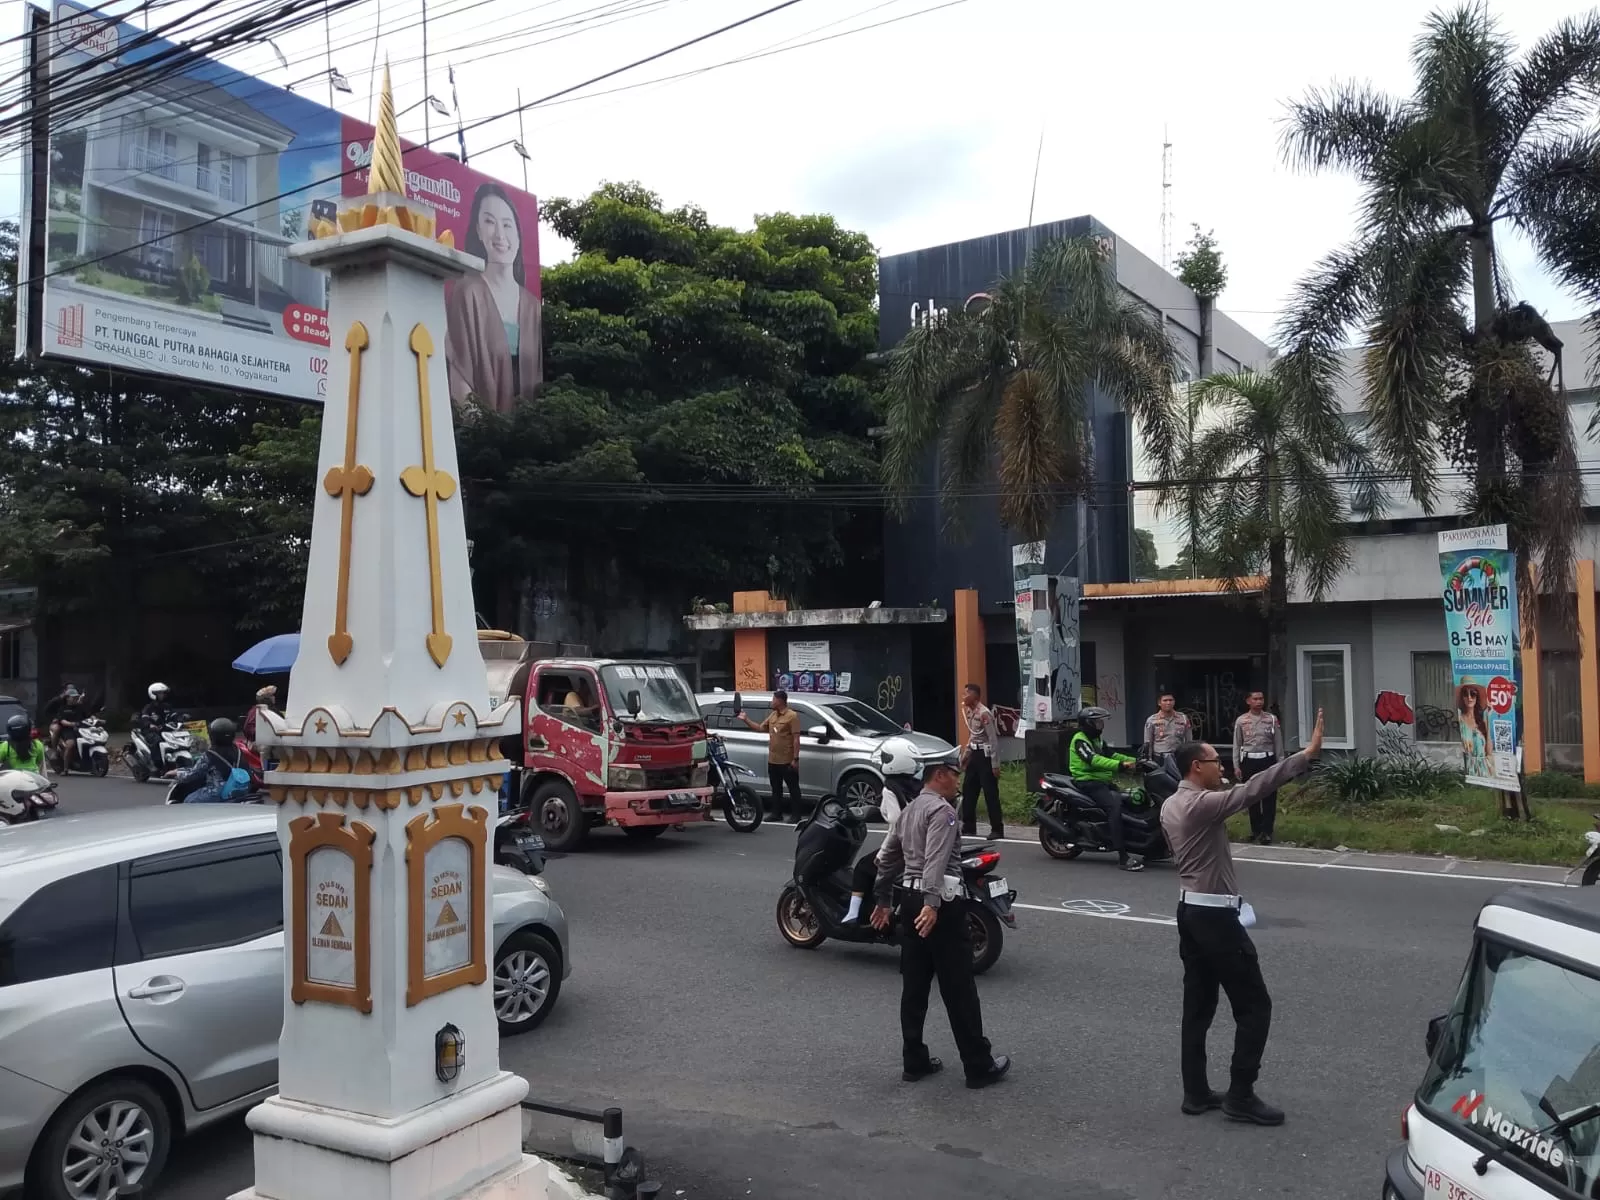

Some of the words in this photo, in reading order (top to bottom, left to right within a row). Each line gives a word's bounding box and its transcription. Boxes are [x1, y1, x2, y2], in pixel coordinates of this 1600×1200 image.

[95, 308, 151, 329] Pengembang
[153, 320, 197, 337] Terpercaya
[303, 312, 319, 323] DP
[303, 325, 330, 341] Ready
[95, 325, 110, 339] PT.
[112, 328, 160, 349] TUNGGAL
[163, 338, 196, 355] PUTRA
[198, 345, 239, 364] BAHAGIA
[241, 354, 291, 374] SEJAHTERA
[94, 341, 133, 359] GRAHA
[171, 355, 200, 369] Suroto
[202, 359, 217, 373] No.
[234, 367, 278, 384] Yogyakarta
[1442, 529, 1481, 542] PAKUWON
[1481, 526, 1503, 538] MALL
[1443, 585, 1509, 612] SUMMER
[1464, 602, 1494, 631] Sale
[1451, 630, 1483, 647] 8-18
[1485, 634, 1509, 646] MAY
[1474, 646, 1506, 658] Atrium
[433, 870, 460, 884] Dusun
[318, 880, 345, 894] Dusun
[431, 881, 463, 900] SEDAN
[315, 892, 349, 909] SEDAN
[1482, 1106, 1564, 1168] Maxride
[1427, 1169, 1442, 1191] AB
